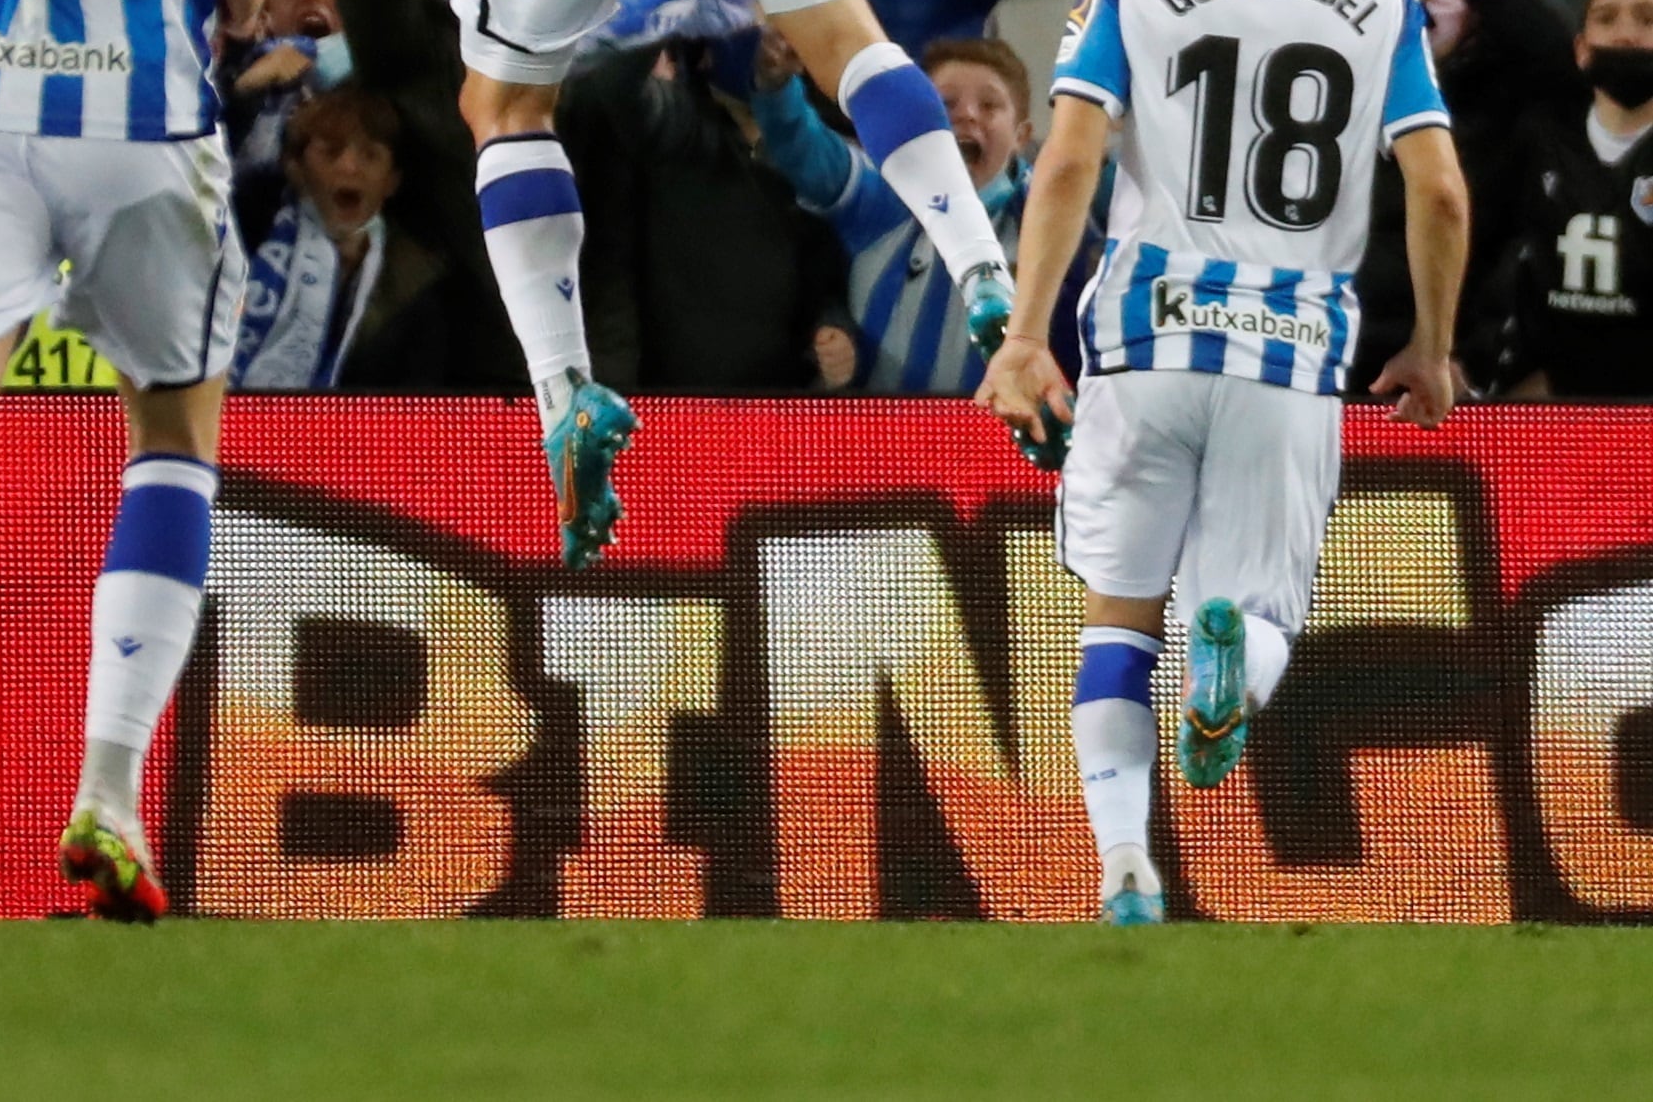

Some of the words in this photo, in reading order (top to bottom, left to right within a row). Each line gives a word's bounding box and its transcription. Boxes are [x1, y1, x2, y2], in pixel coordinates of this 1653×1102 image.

[1165, 33, 1355, 233] 18
[1556, 213, 1617, 294] fi
[1155, 281, 1330, 349] Kutxabank
[13, 336, 98, 385] 417
